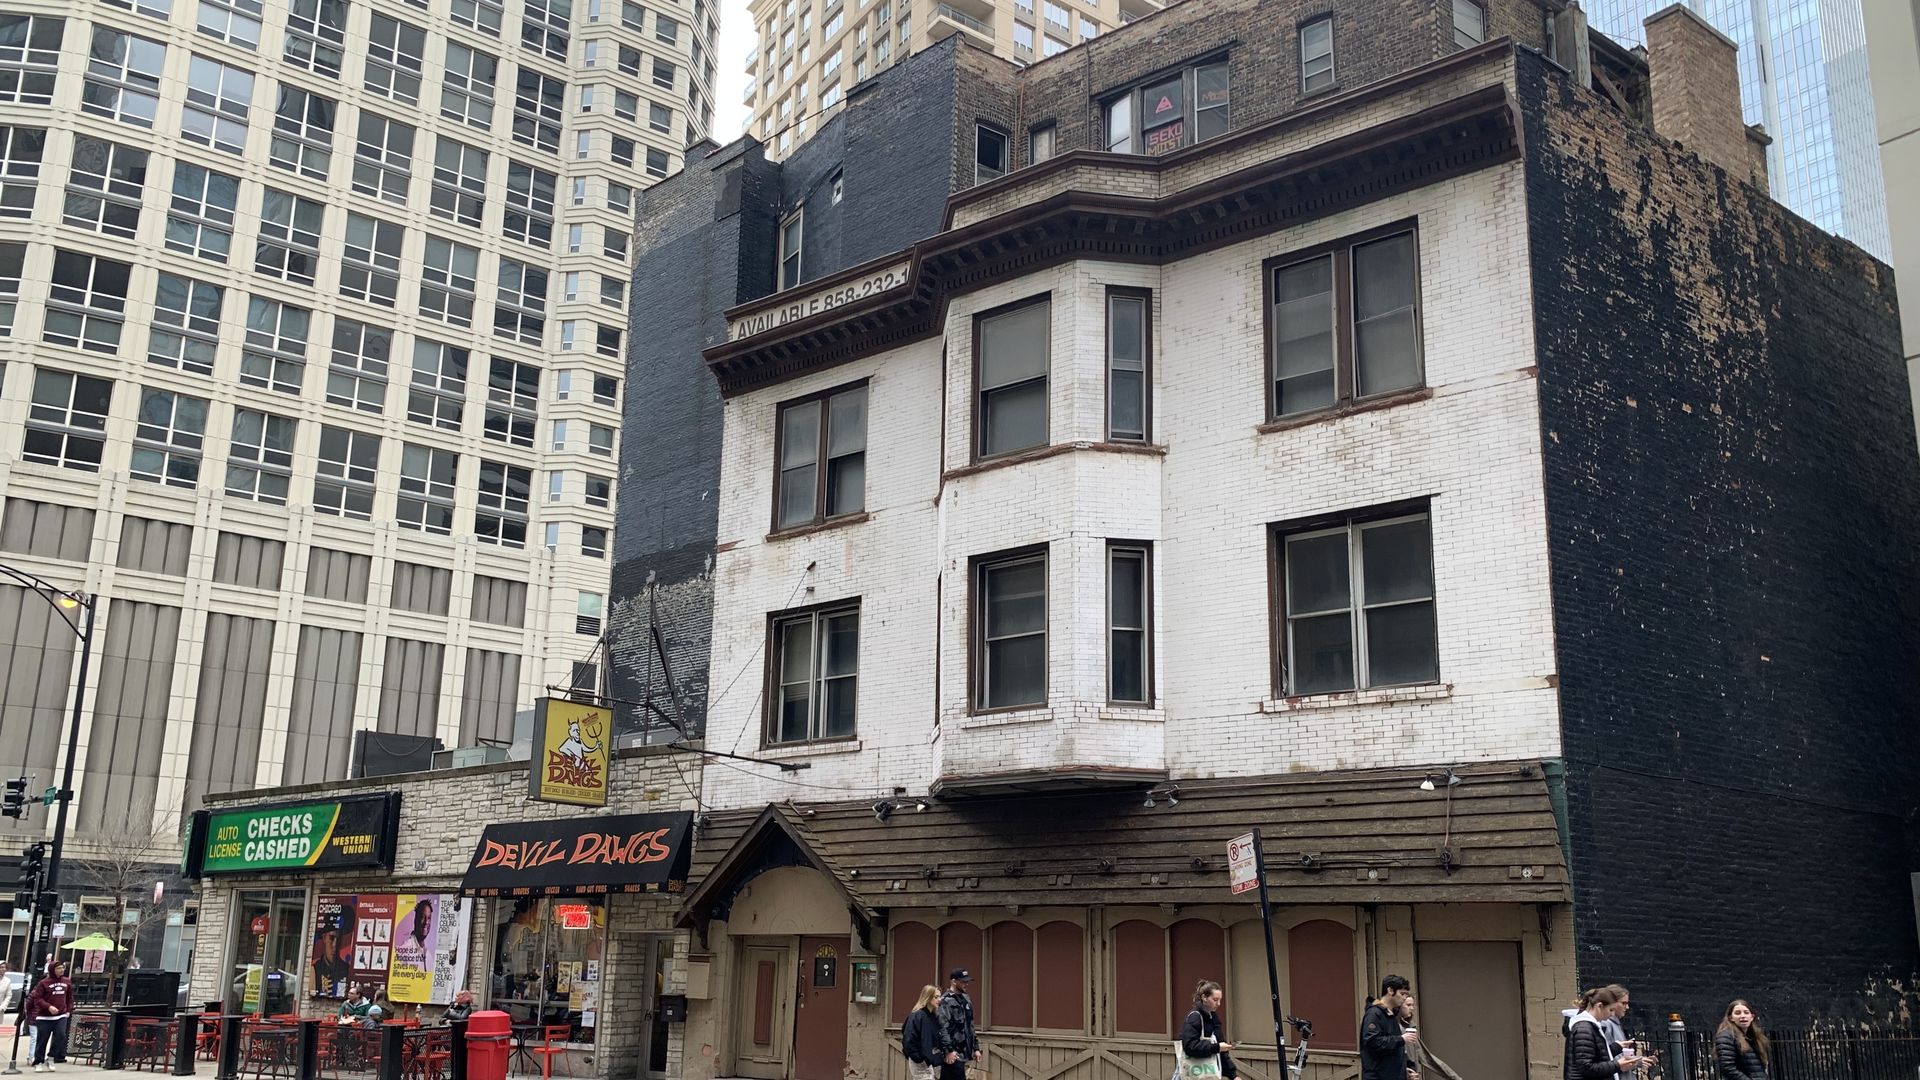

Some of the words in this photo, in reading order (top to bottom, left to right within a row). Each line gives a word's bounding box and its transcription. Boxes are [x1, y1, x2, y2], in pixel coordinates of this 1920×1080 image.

[547, 750, 602, 771] DEVIL
[547, 766, 603, 788] DAWGS
[217, 826, 239, 841] AUTO
[247, 813, 313, 839] CHECKS
[332, 835, 371, 846] WESTERN
[208, 842, 243, 859] LICENSE
[244, 837, 311, 862] CASHED
[342, 844, 370, 855] UNION
[475, 838, 566, 871] DEVIL
[566, 828, 671, 866] DAWGS
[318, 905, 342, 914] CHICAGO
[395, 947, 409, 955] Hope
[401, 970, 416, 979] every
[409, 964, 418, 972] my
